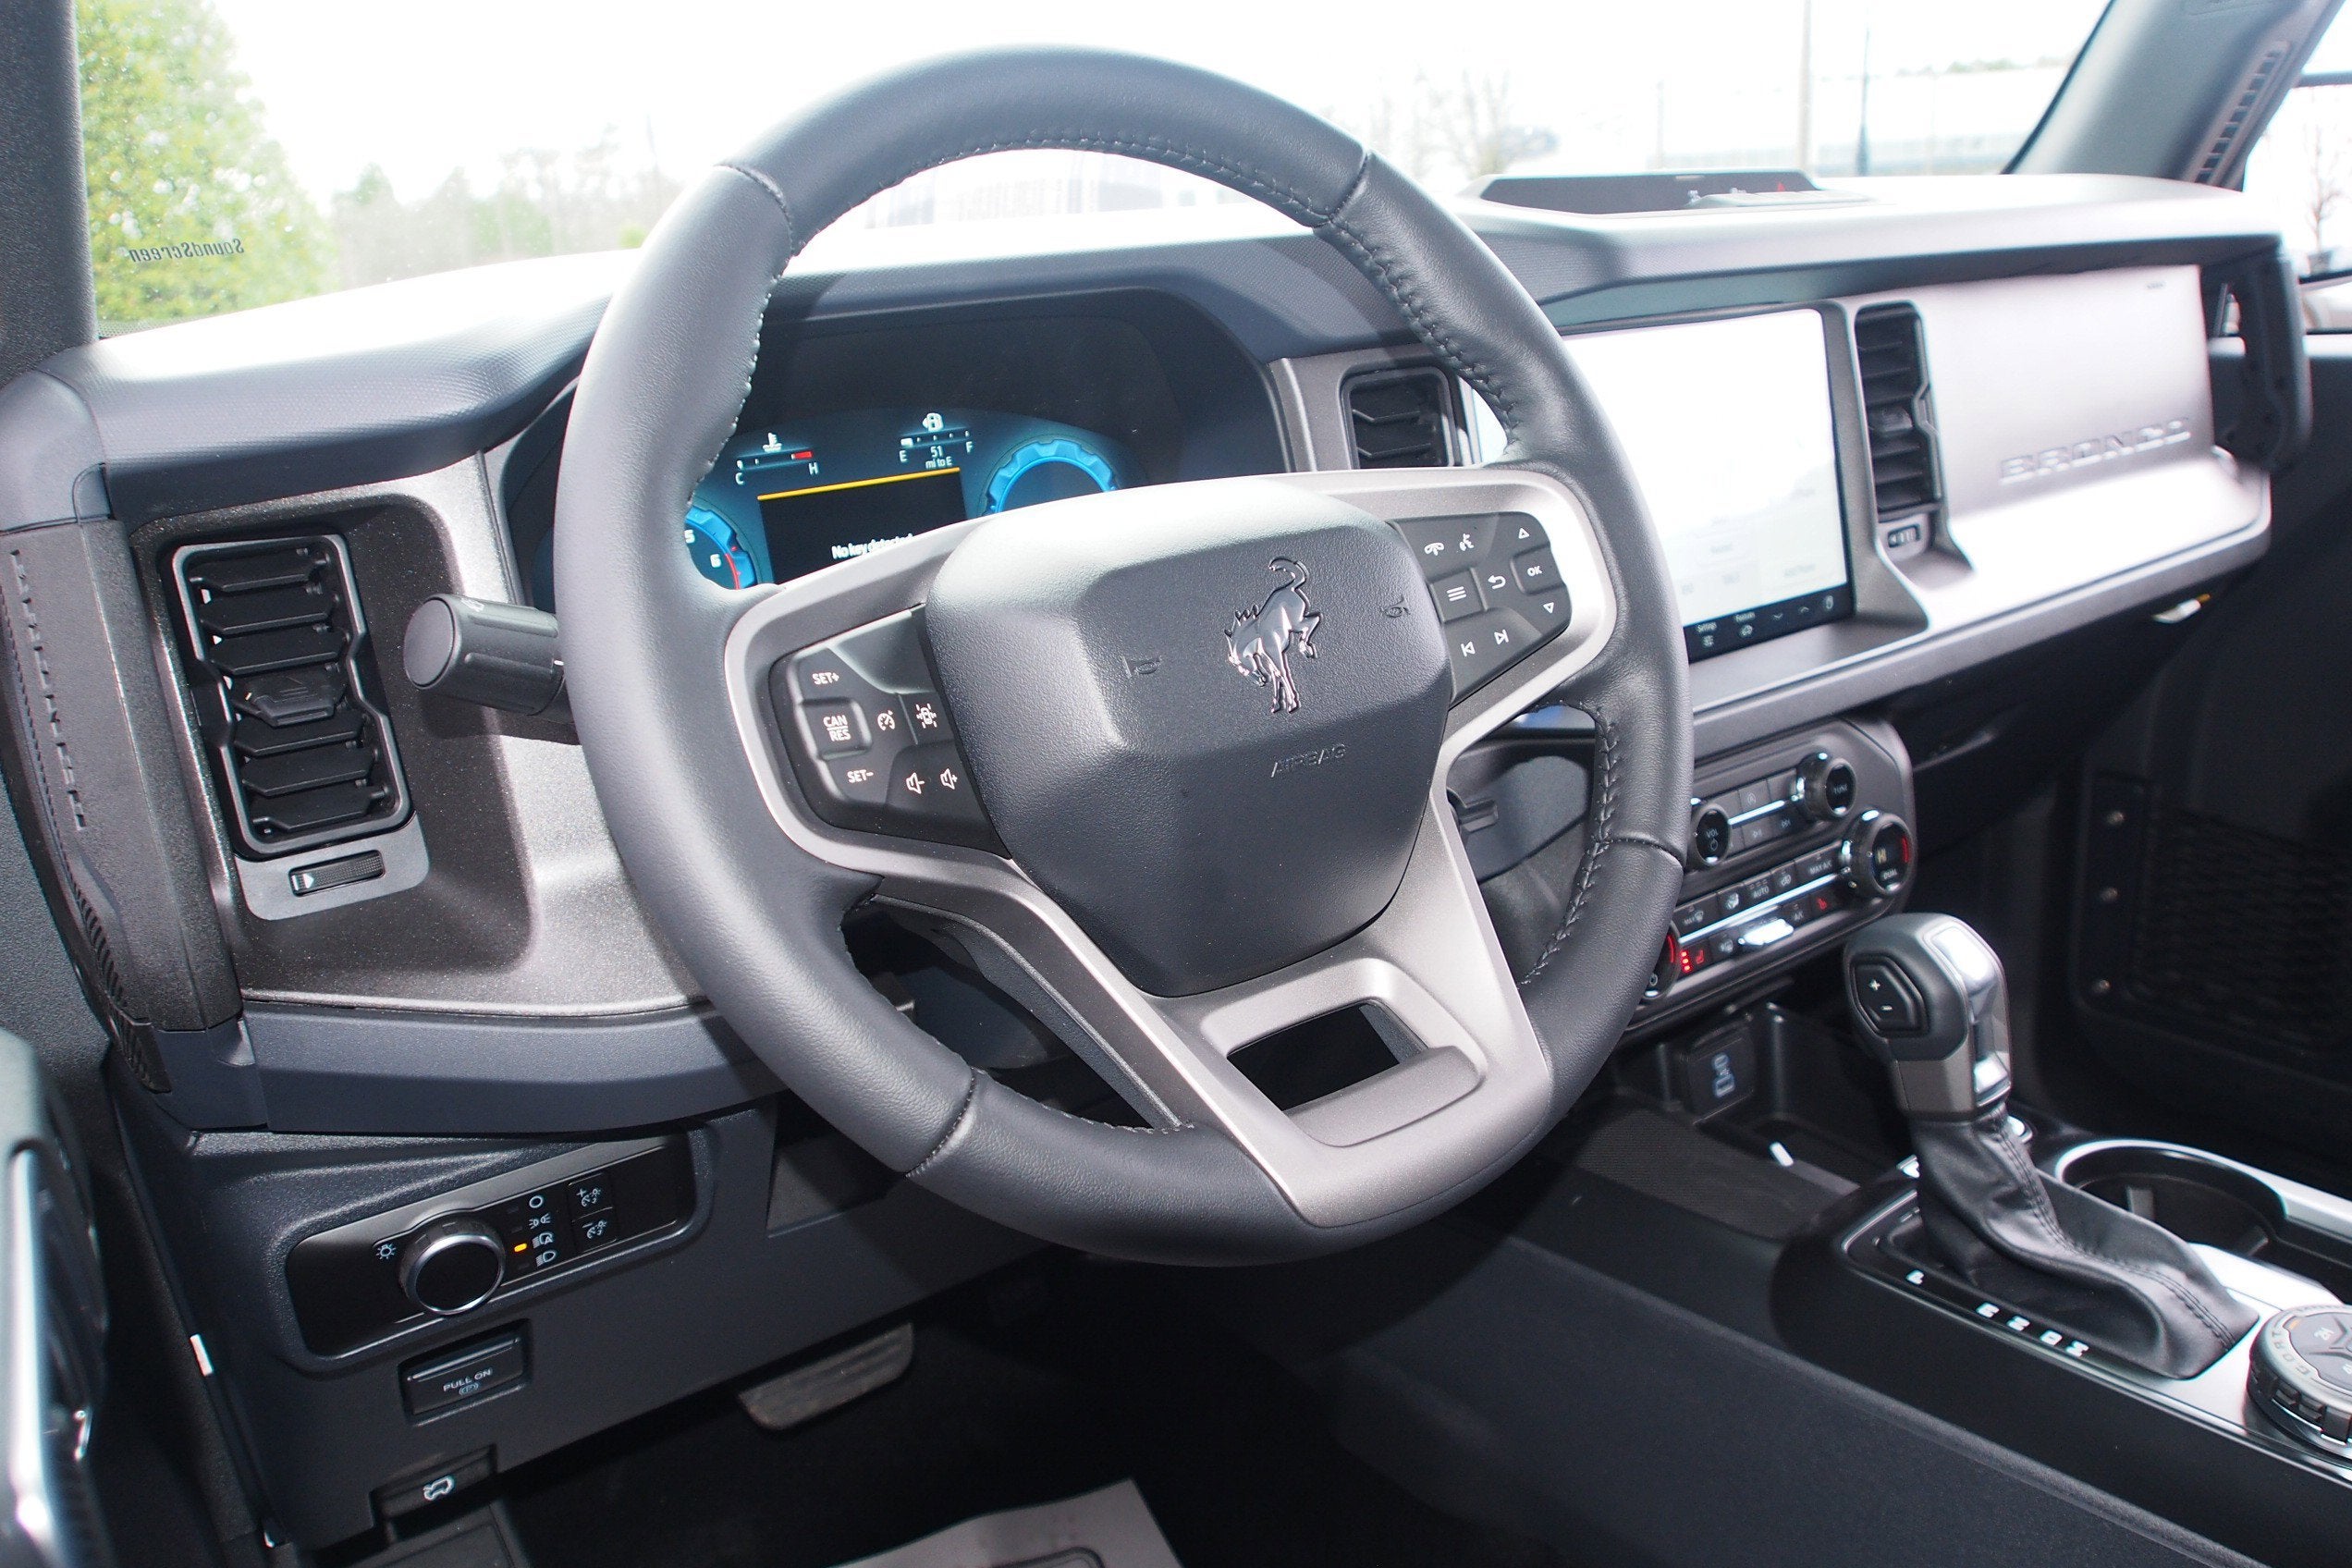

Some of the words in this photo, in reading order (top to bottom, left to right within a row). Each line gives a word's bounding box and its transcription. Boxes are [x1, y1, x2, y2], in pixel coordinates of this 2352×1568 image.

[899, 449, 908, 463] E
[930, 445, 943, 458] 51
[808, 462, 819, 475] H
[735, 472, 744, 485] C
[831, 545, 849, 559] No
[1526, 565, 1543, 577] OK
[823, 715, 848, 728] CAN
[828, 729, 851, 742] RES
[443, 1376, 472, 1392] PULL
[474, 1367, 493, 1380] ON
